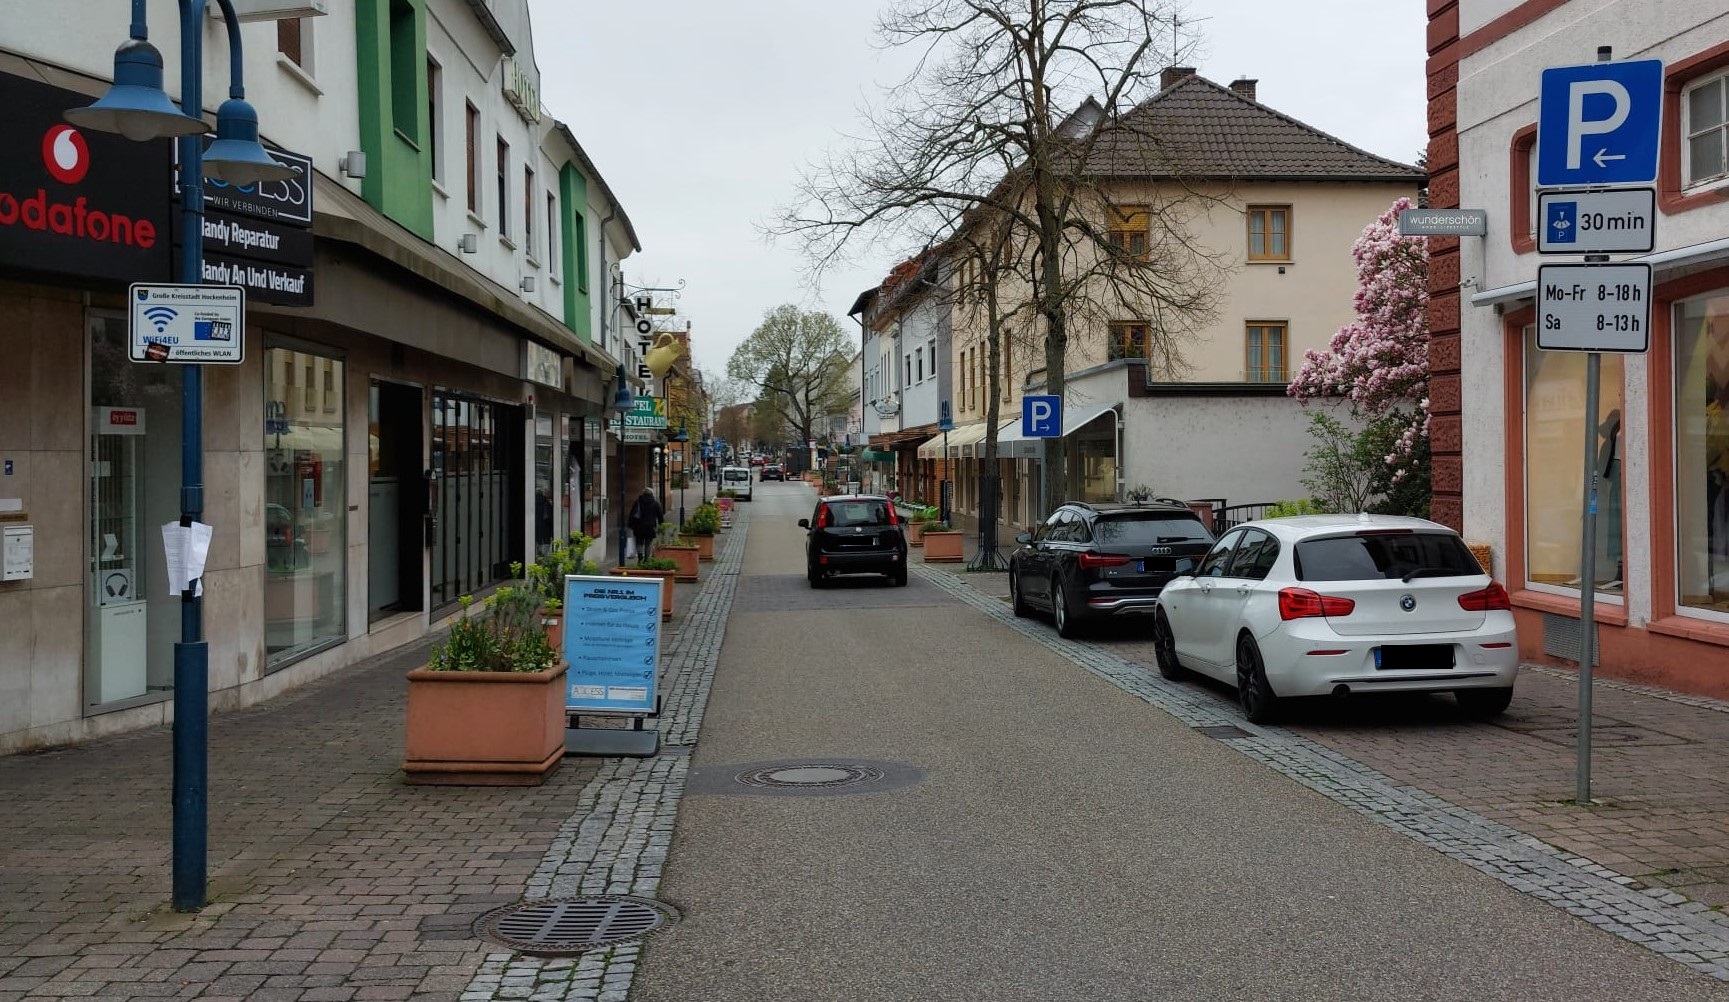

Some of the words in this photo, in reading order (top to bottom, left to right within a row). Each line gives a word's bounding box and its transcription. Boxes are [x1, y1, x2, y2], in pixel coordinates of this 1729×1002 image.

[1567, 80, 1631, 170] P
[213, 196, 229, 207] WIR
[232, 202, 278, 218] VERBINDEN
[0, 189, 156, 248] odafone
[1410, 215, 1481, 225] wunderschön
[1581, 213, 1604, 231] 30
[1607, 211, 1645, 230] min
[231, 222, 280, 250] Reparatur
[1558, 231, 1565, 240] P
[232, 264, 246, 286] An
[247, 267, 268, 289] Und
[268, 270, 305, 294] Verkauf
[1546, 284, 1586, 301] Mo-Fr
[1598, 284, 1630, 301] 8-18
[1633, 284, 1641, 301] h
[1545, 314, 1561, 330] Sa
[1596, 314, 1629, 332] 8-13
[1632, 314, 1640, 331] h
[143, 336, 179, 345] WiFi4EU
[1031, 401, 1052, 432] P
